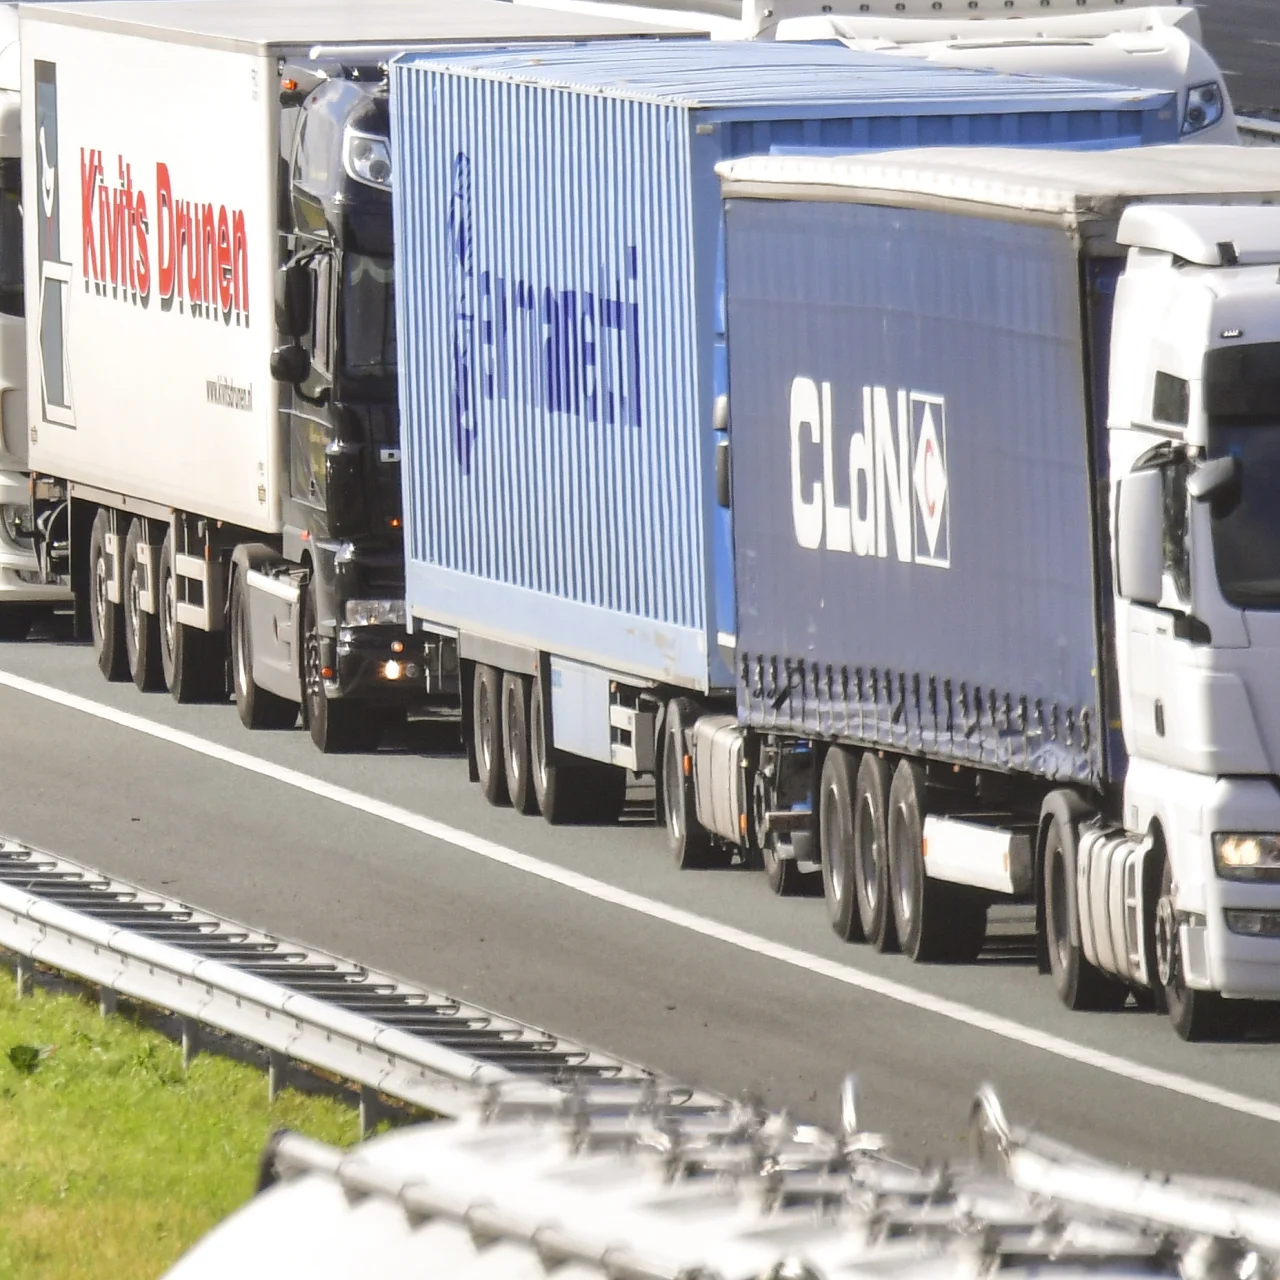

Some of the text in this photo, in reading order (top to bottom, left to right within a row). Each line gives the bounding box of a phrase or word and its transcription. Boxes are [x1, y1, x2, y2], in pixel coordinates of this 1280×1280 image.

[80, 146, 250, 329] Kivits Drunen
[789, 375, 912, 564] CLdN
